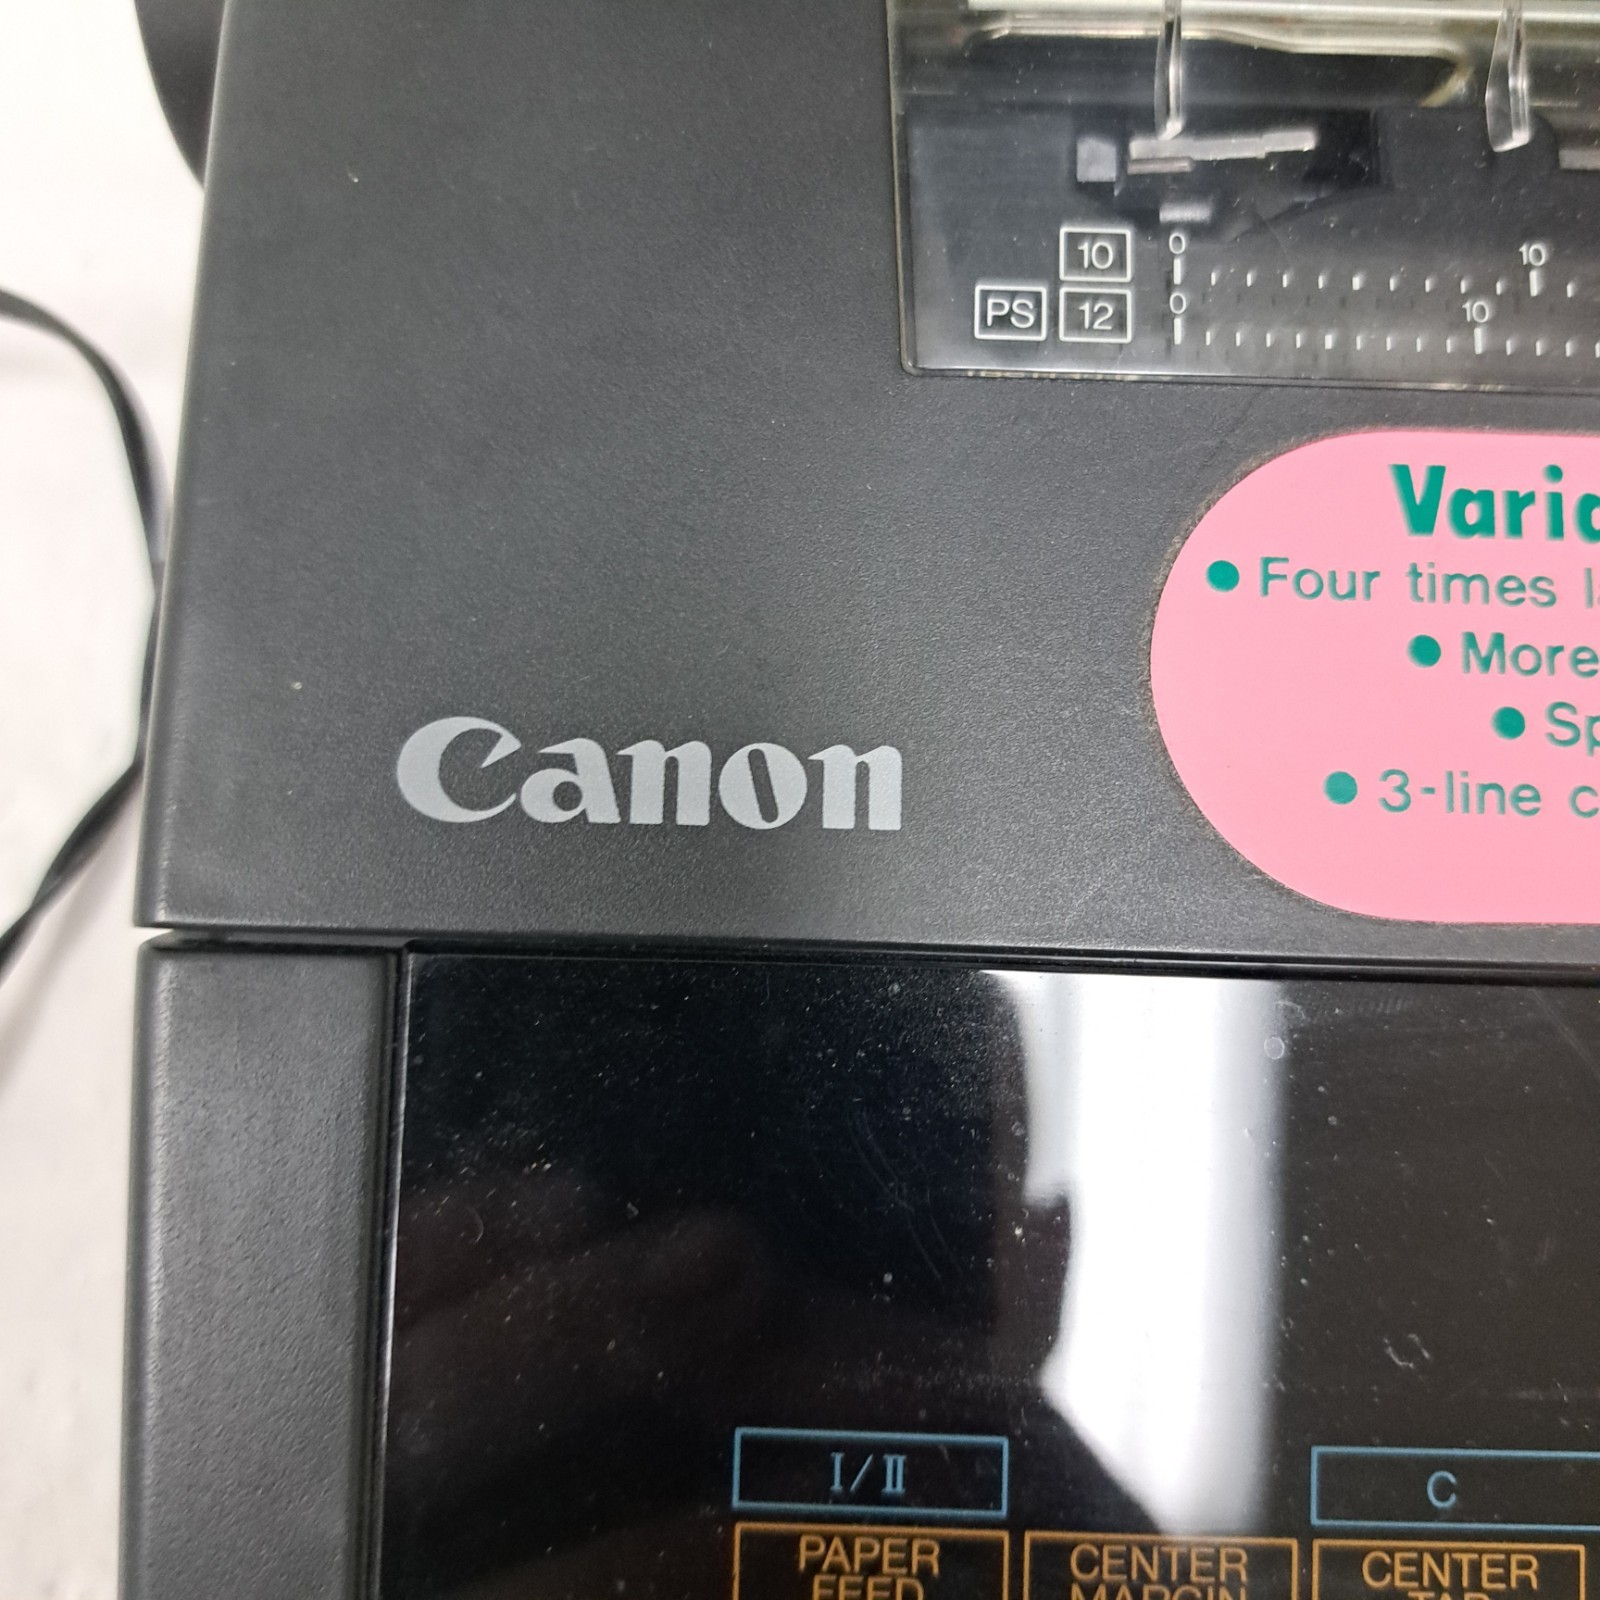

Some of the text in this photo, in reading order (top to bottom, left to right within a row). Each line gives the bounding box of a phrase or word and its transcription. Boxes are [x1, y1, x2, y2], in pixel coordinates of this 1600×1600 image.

[1078, 233, 1546, 270] 10 0 10
[986, 292, 1489, 330] PS 12 0 10
[1259, 555, 1600, 609] Four times l
[1460, 631, 1599, 679] More
[397, 716, 903, 831] Canon
[1378, 768, 1542, 817] 3-line
[1426, 1470, 1457, 1508] C
[798, 1534, 941, 1578] PAPER
[1069, 1542, 1249, 1584] CENTER
[1361, 1551, 1539, 1590] CENTER
